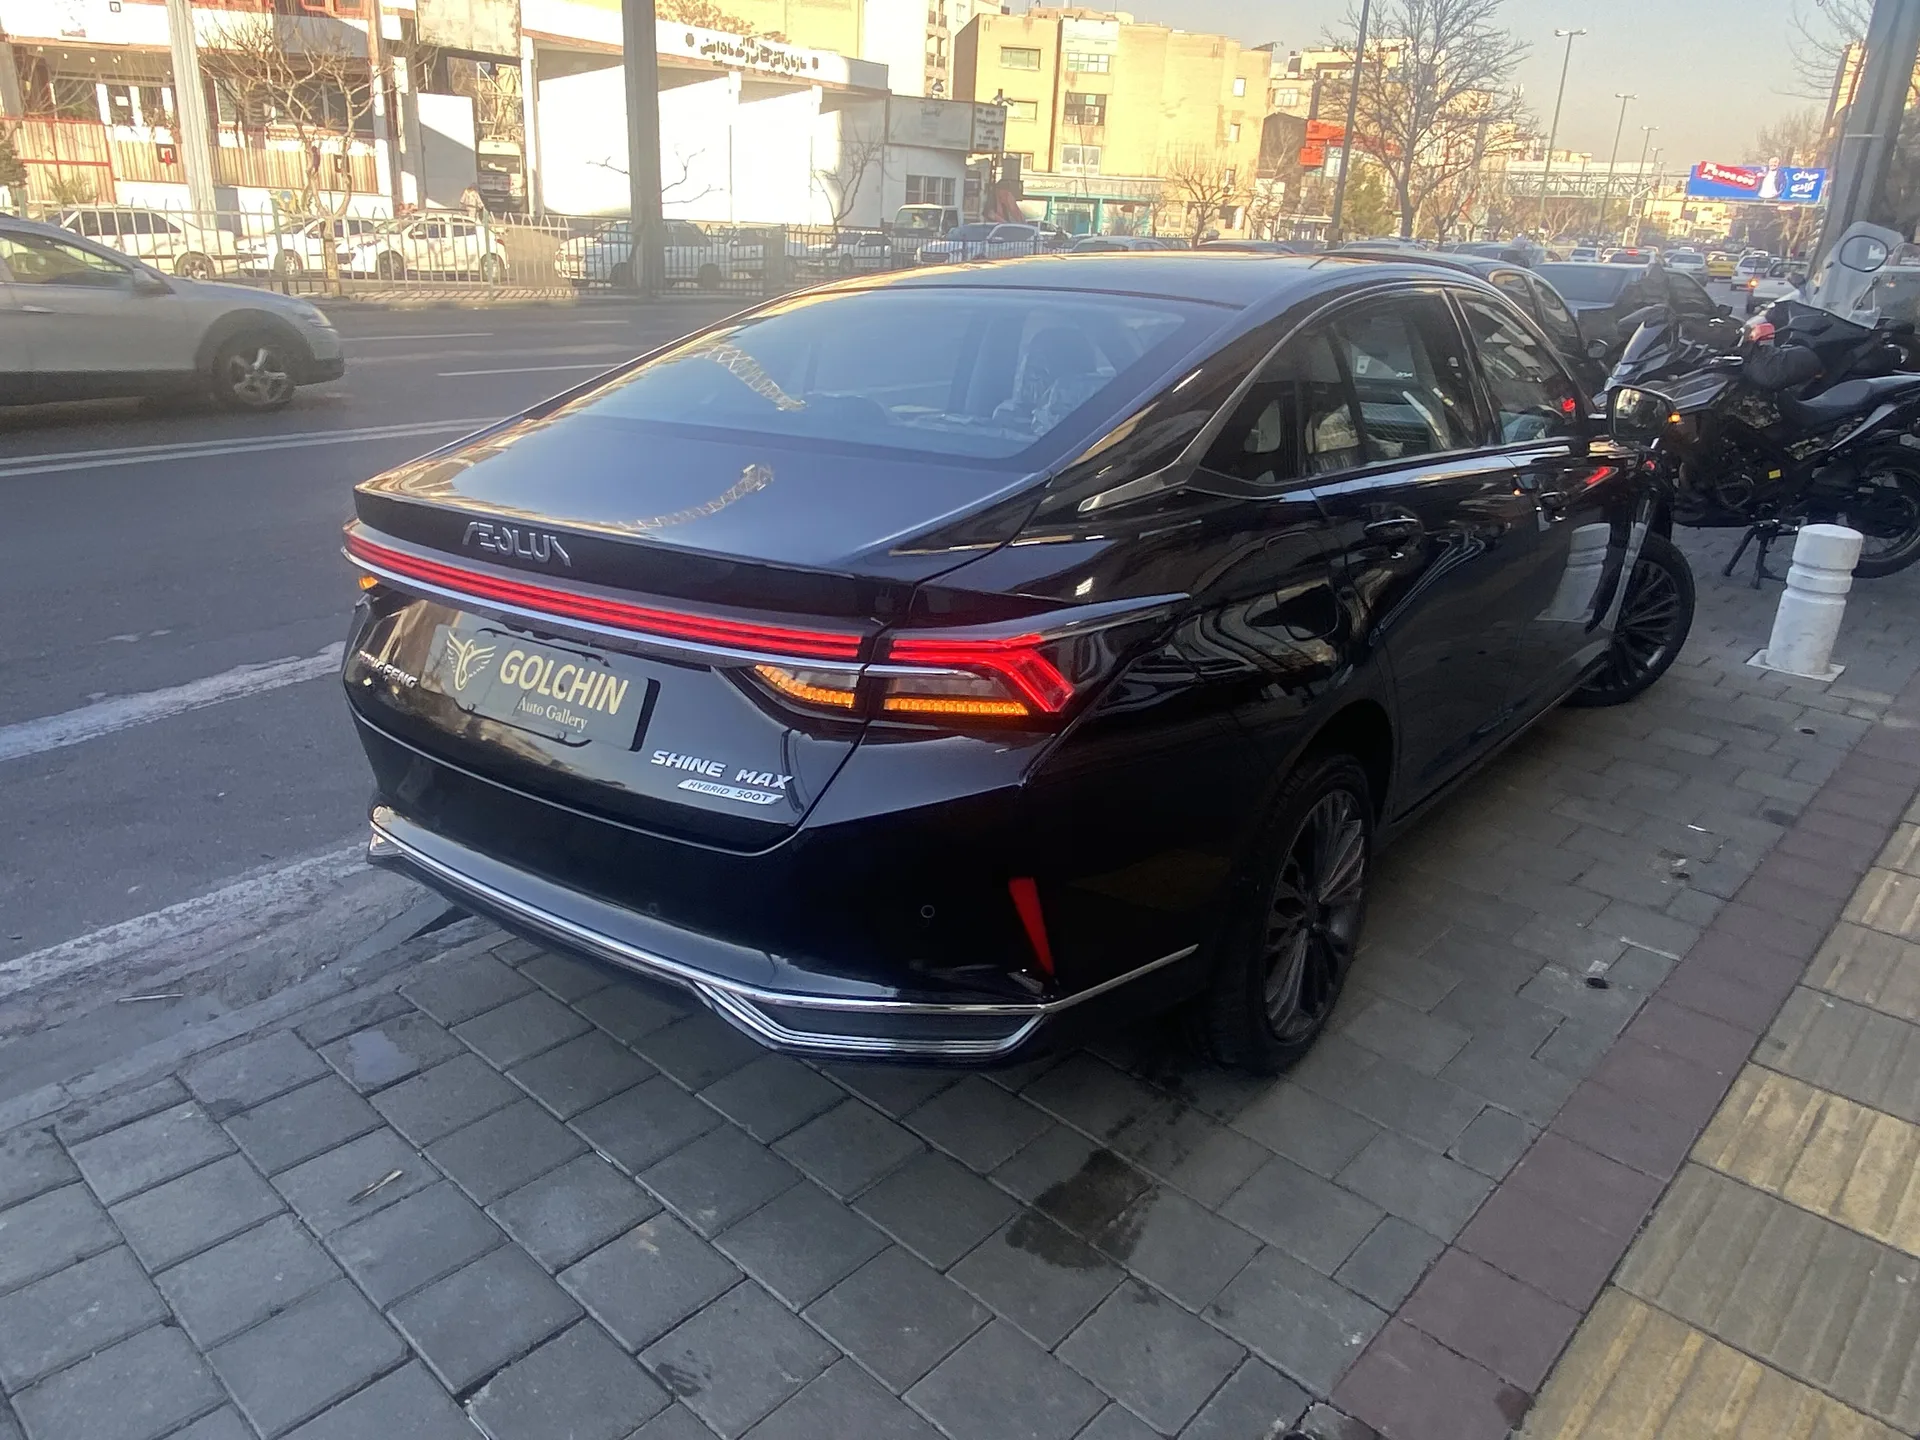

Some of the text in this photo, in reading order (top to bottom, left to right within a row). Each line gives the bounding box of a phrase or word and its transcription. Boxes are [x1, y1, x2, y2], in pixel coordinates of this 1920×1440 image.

[784, 54, 806, 72] سازمان
[500, 650, 629, 716] GOLCHIN
[517, 697, 588, 734] Auto Gallery
[650, 750, 793, 790] SHINE MAX
[688, 781, 772, 803] HYBRID 500T
